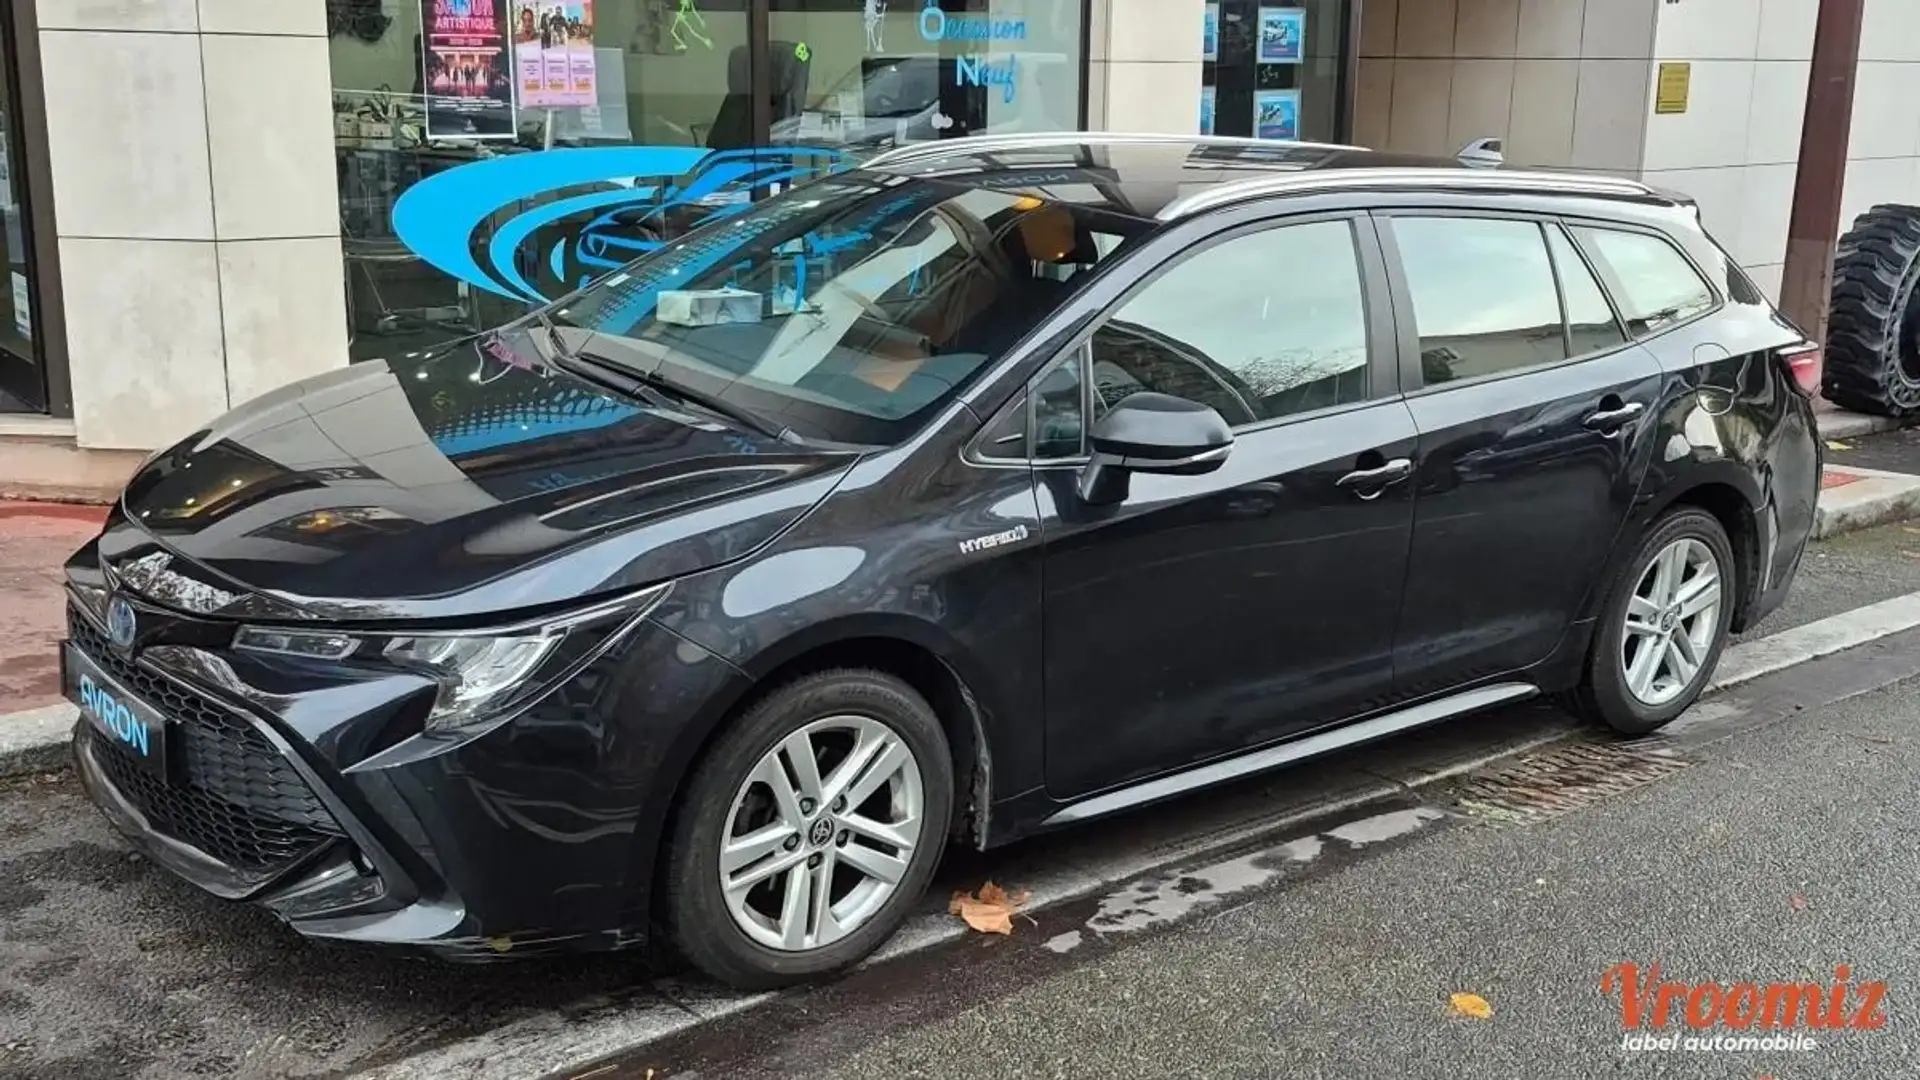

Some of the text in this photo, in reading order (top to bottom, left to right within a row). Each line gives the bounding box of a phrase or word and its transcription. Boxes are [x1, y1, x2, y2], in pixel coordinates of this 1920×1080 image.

[435, 17, 496, 30] ARTISTIQUE
[956, 53, 1015, 103] Neuf
[959, 528, 1017, 554] HYBRID
[79, 673, 149, 757] AVRON
